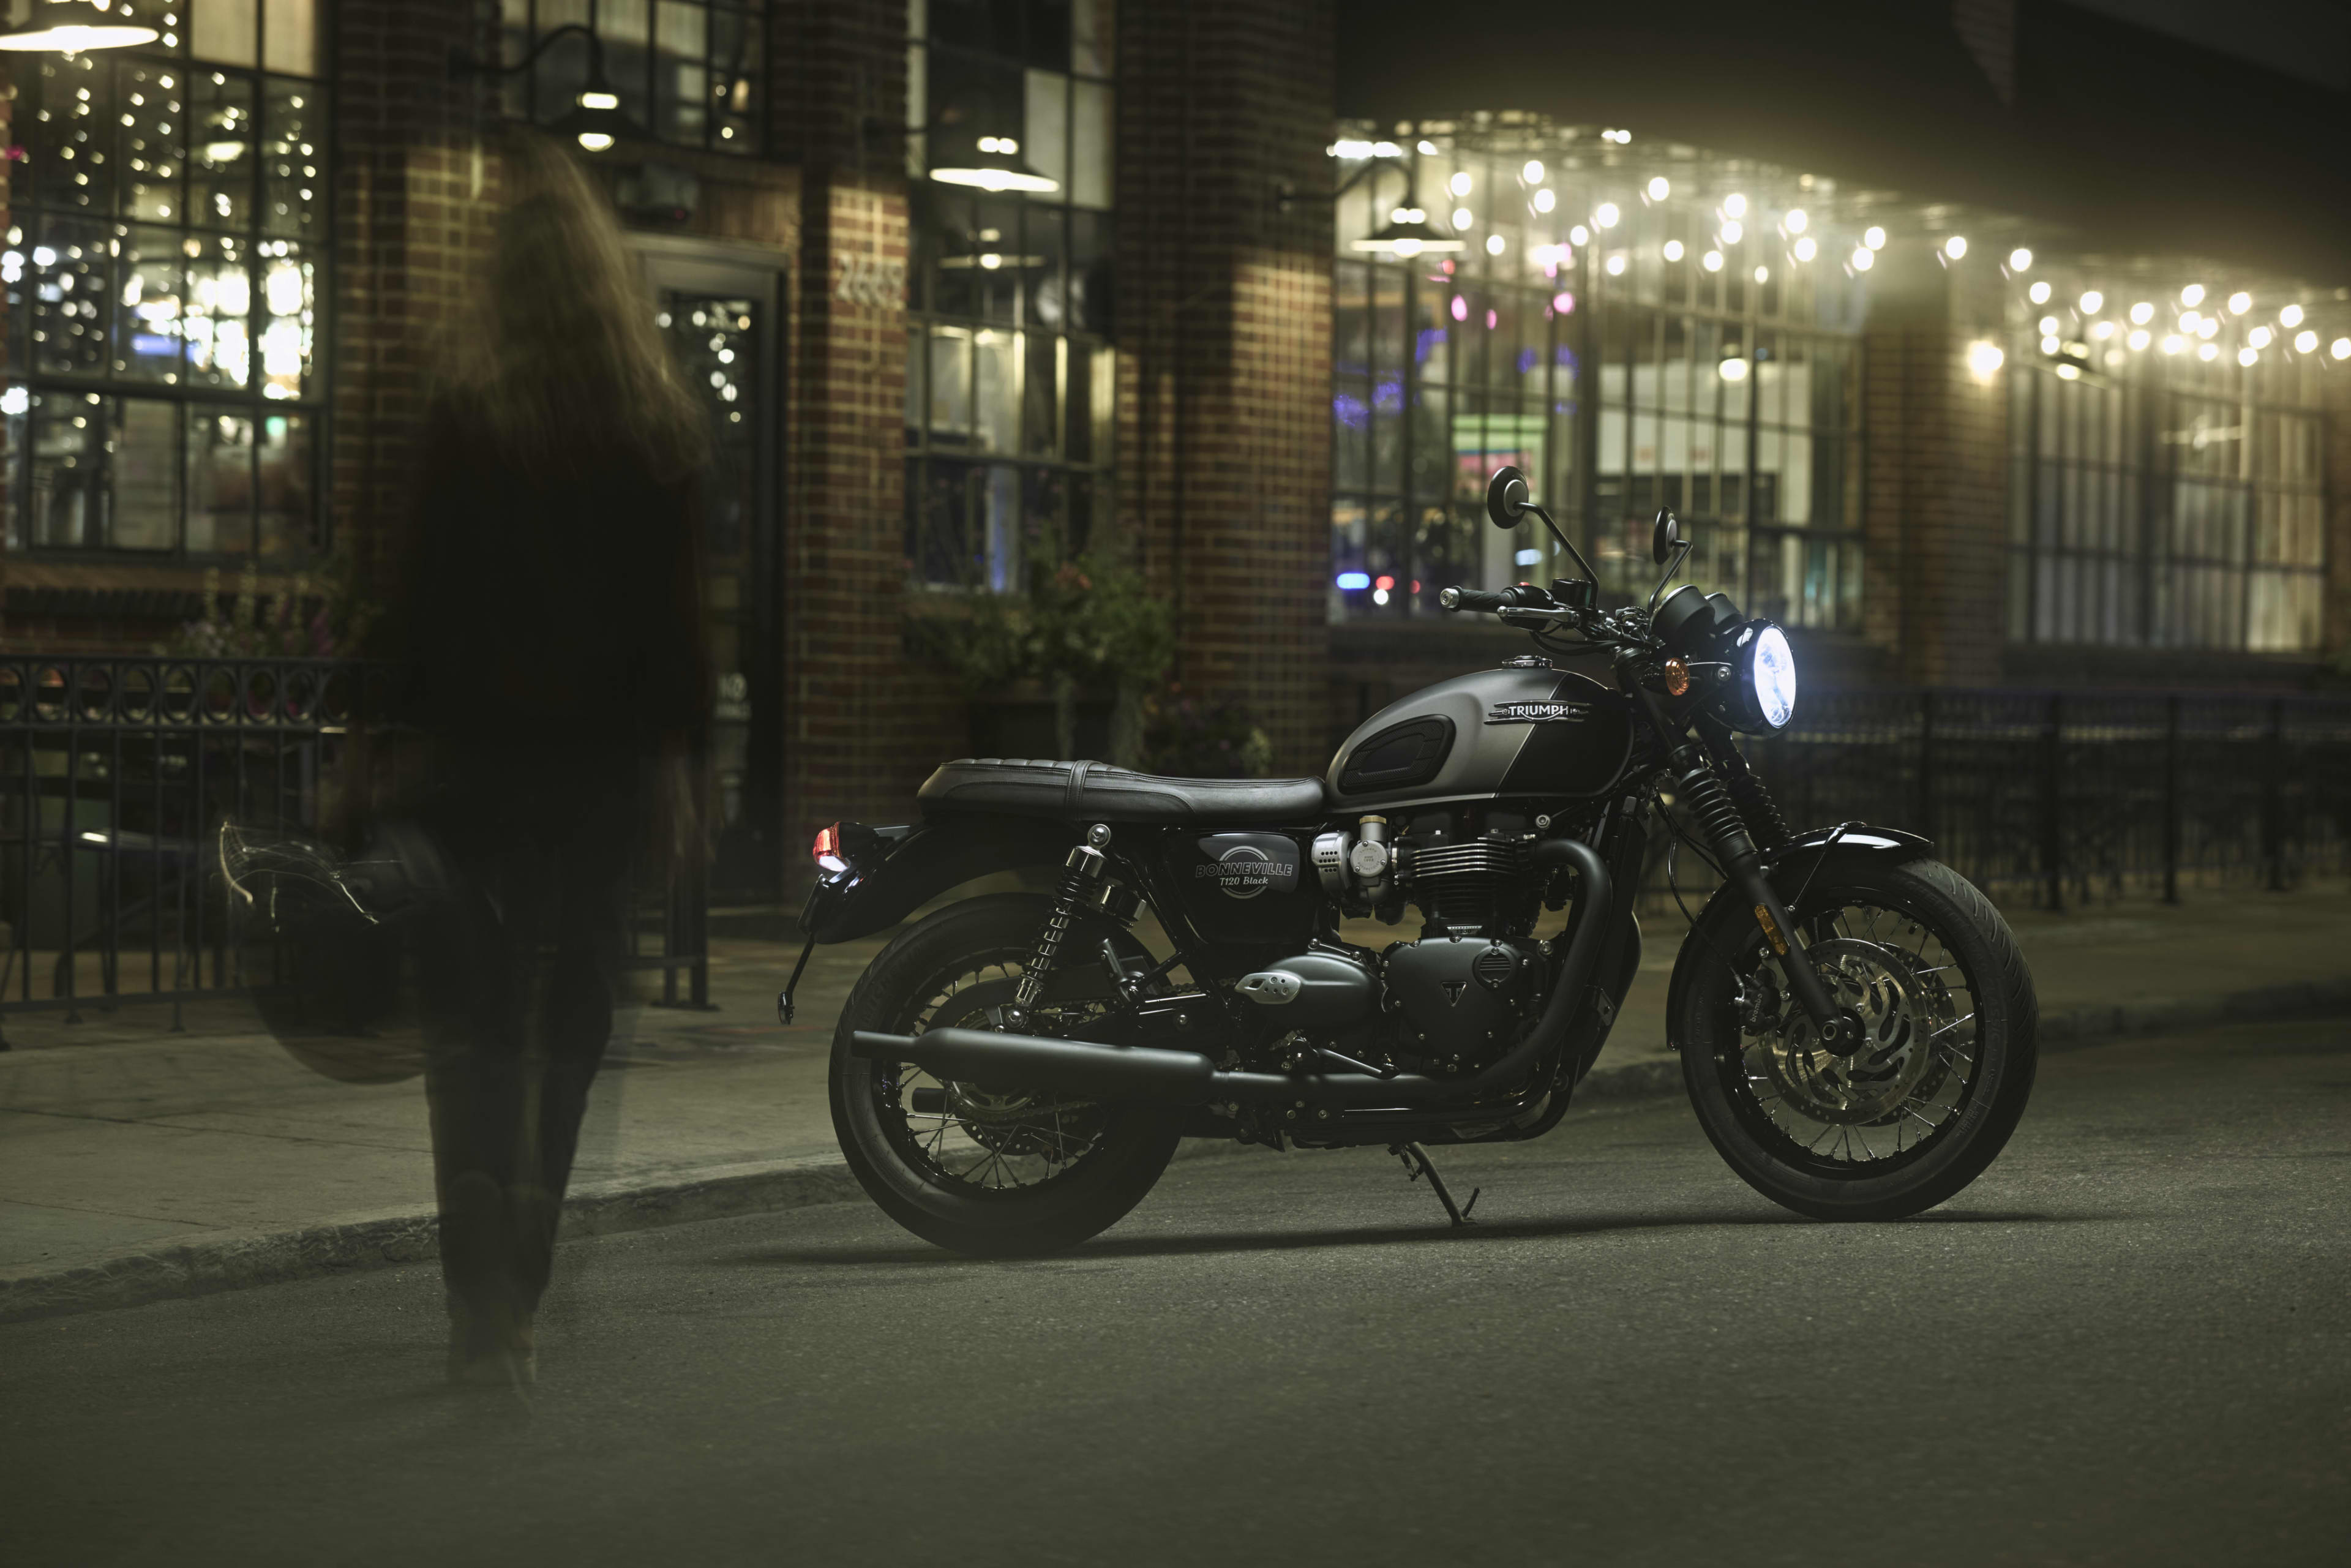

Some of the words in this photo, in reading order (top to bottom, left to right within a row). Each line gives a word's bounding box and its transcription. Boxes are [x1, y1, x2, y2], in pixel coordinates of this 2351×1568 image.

[1509, 705, 1569, 719] TRIUMPH
[1195, 862, 1293, 877] BONNEVILLE
[1220, 877, 1240, 886] T120
[1243, 876, 1269, 885] Black
[1750, 992, 1763, 1022] brembo
